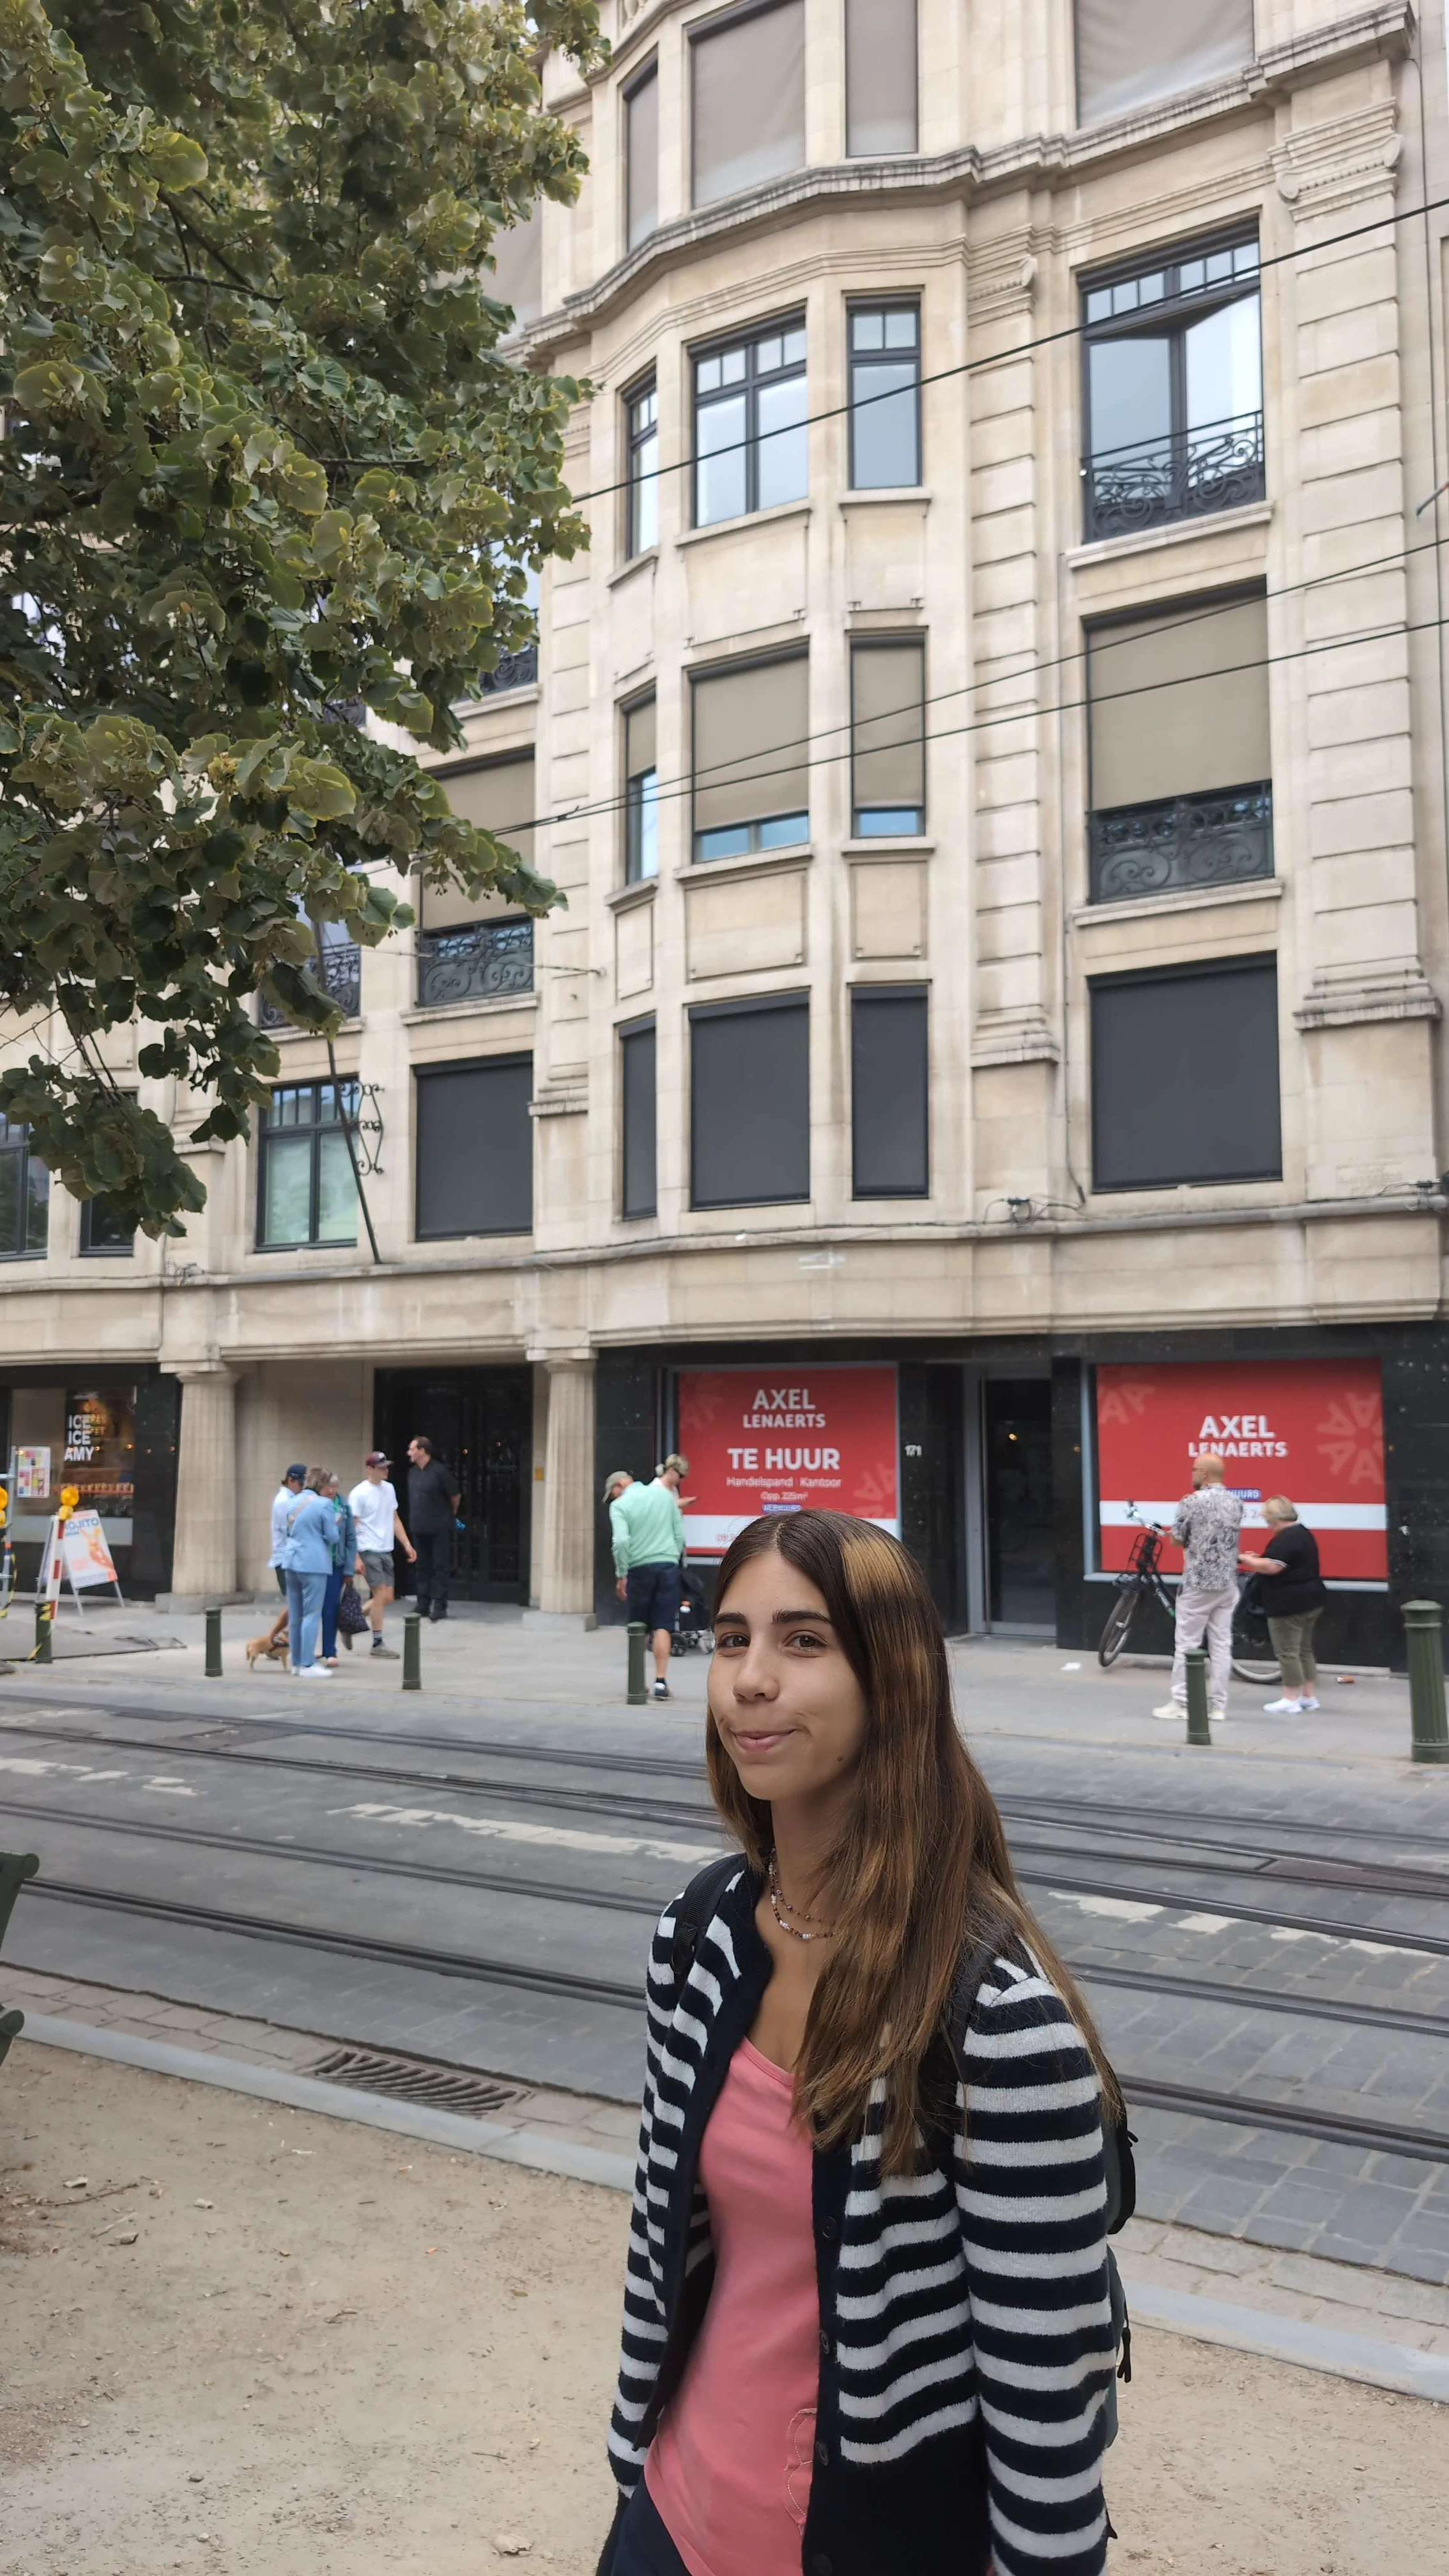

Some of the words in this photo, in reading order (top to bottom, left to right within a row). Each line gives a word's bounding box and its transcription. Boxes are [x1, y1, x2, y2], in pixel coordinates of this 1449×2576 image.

[752, 1388, 816, 1410] AXEL
[69, 1414, 91, 1429] ICE
[743, 1414, 825, 1429] LENAERTS
[1199, 1415, 1275, 1438] AXEL
[68, 1430, 91, 1445] ICE
[64, 1446, 95, 1462] AMY
[905, 1445, 922, 1457] 171
[1188, 1441, 1288, 1457] LENAERTS
[727, 1447, 759, 1470] TE
[765, 1447, 840, 1470] HUUR
[726, 1476, 793, 1488] Handelspand
[799, 1477, 841, 1487] Kantoor
